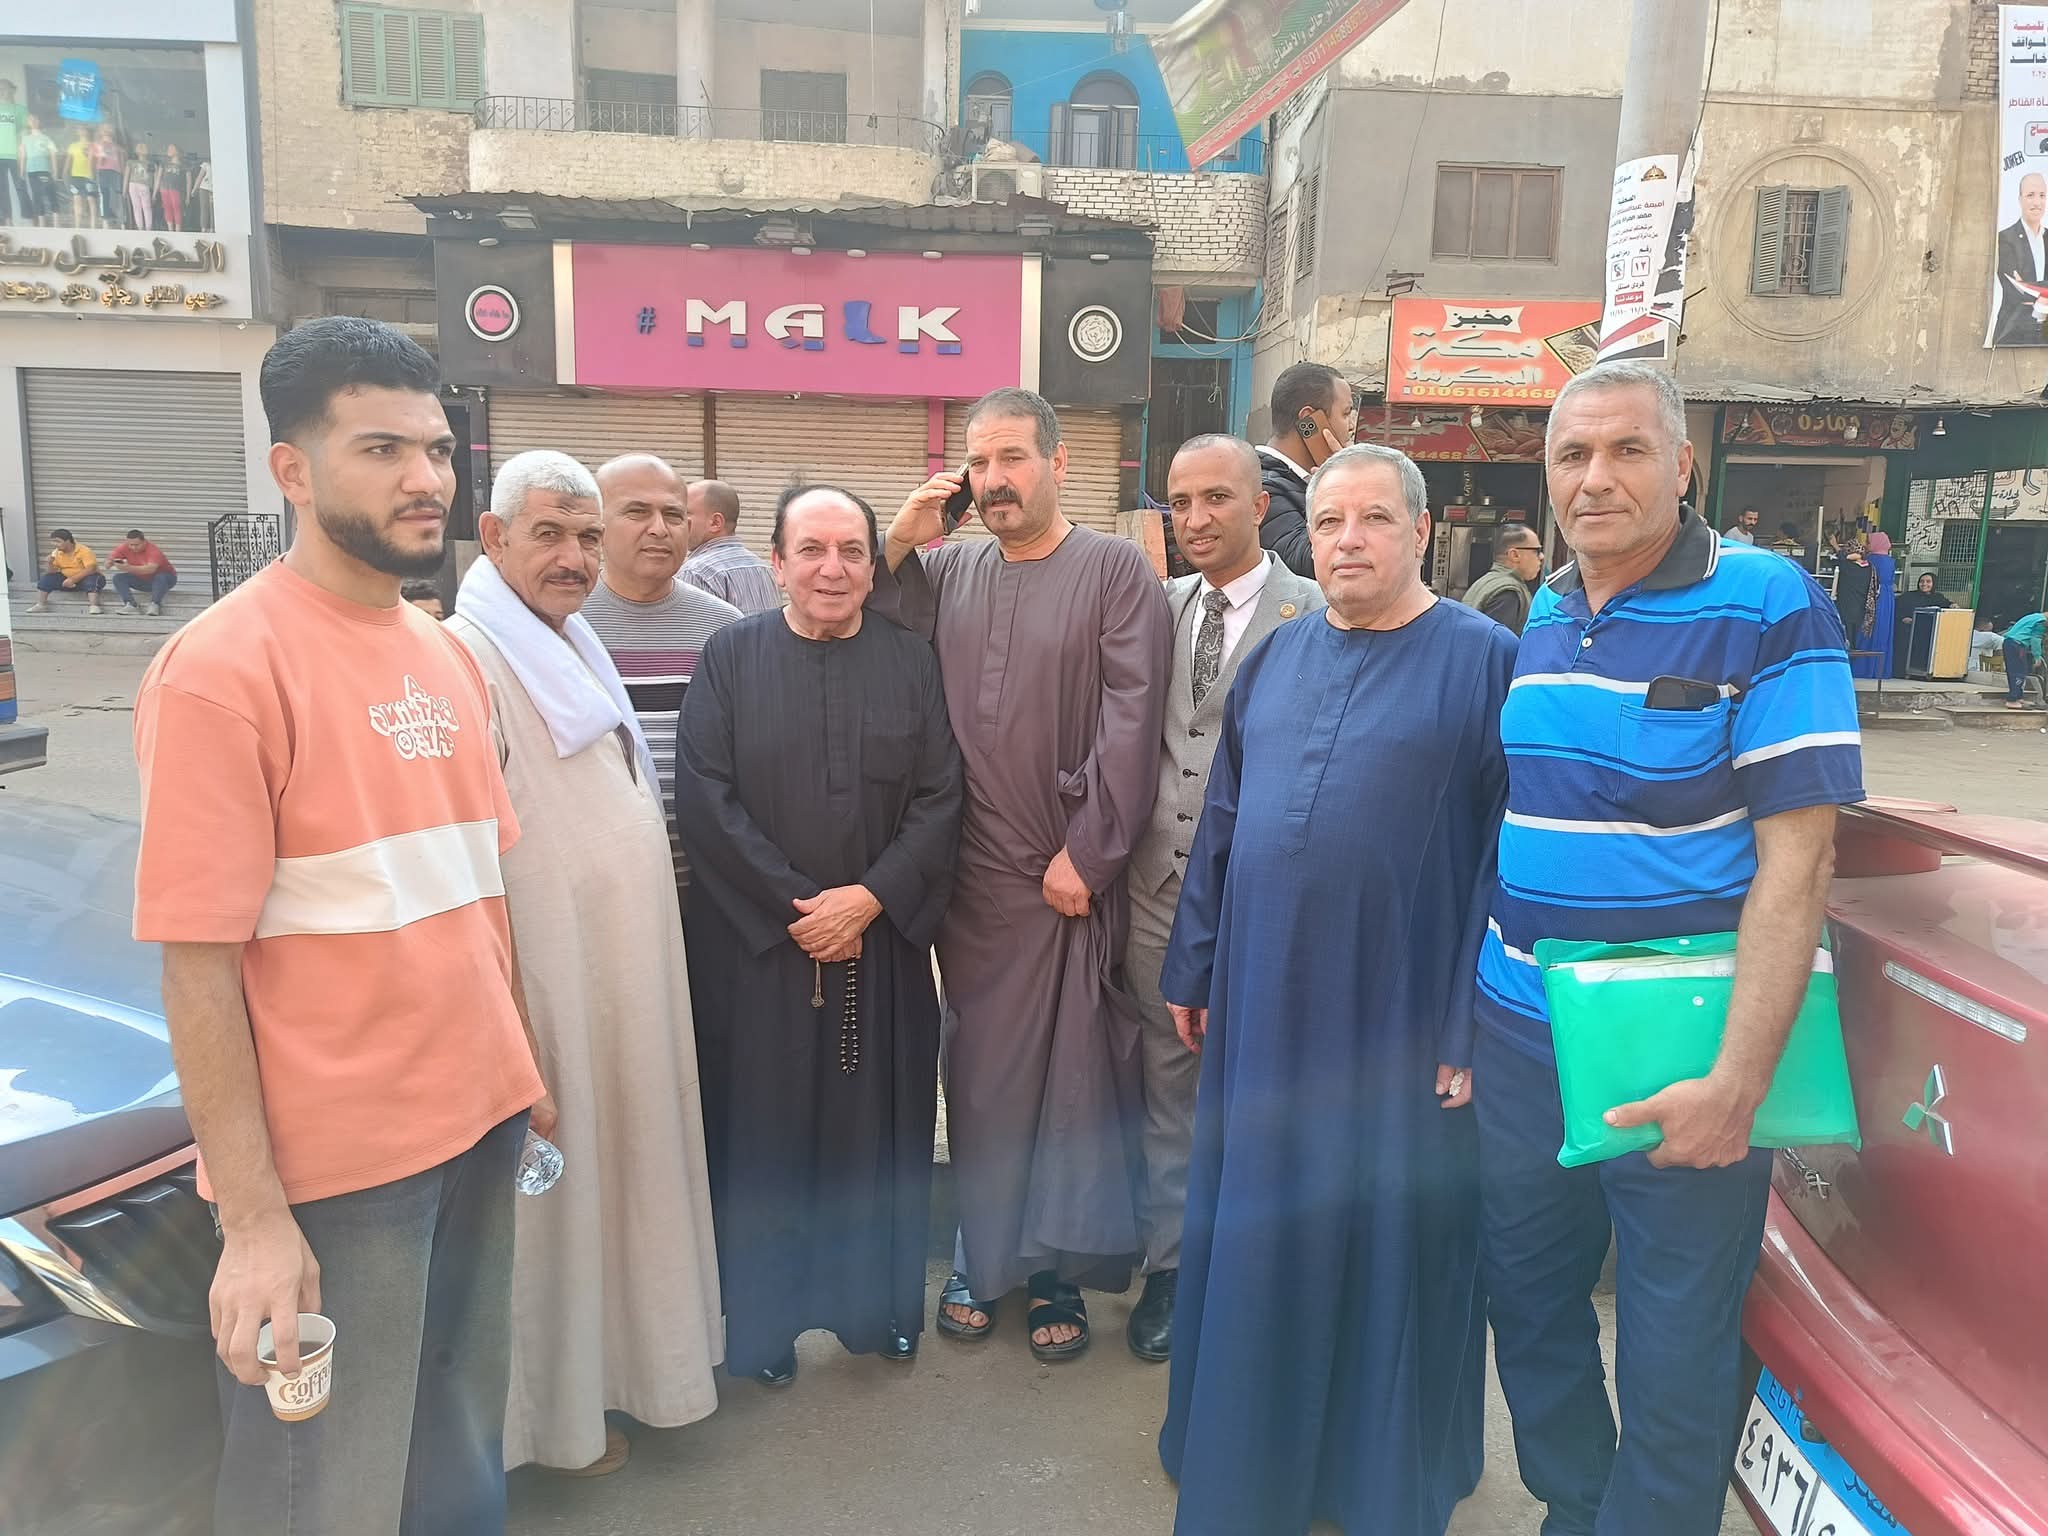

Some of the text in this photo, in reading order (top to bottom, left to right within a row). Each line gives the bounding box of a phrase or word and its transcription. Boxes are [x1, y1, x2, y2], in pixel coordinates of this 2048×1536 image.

[54, 234, 225, 284] الطويل
[1450, 309, 1513, 329] مخبز
[1409, 327, 1543, 361] مكة
[1412, 385, 1557, 399] 01061614468
